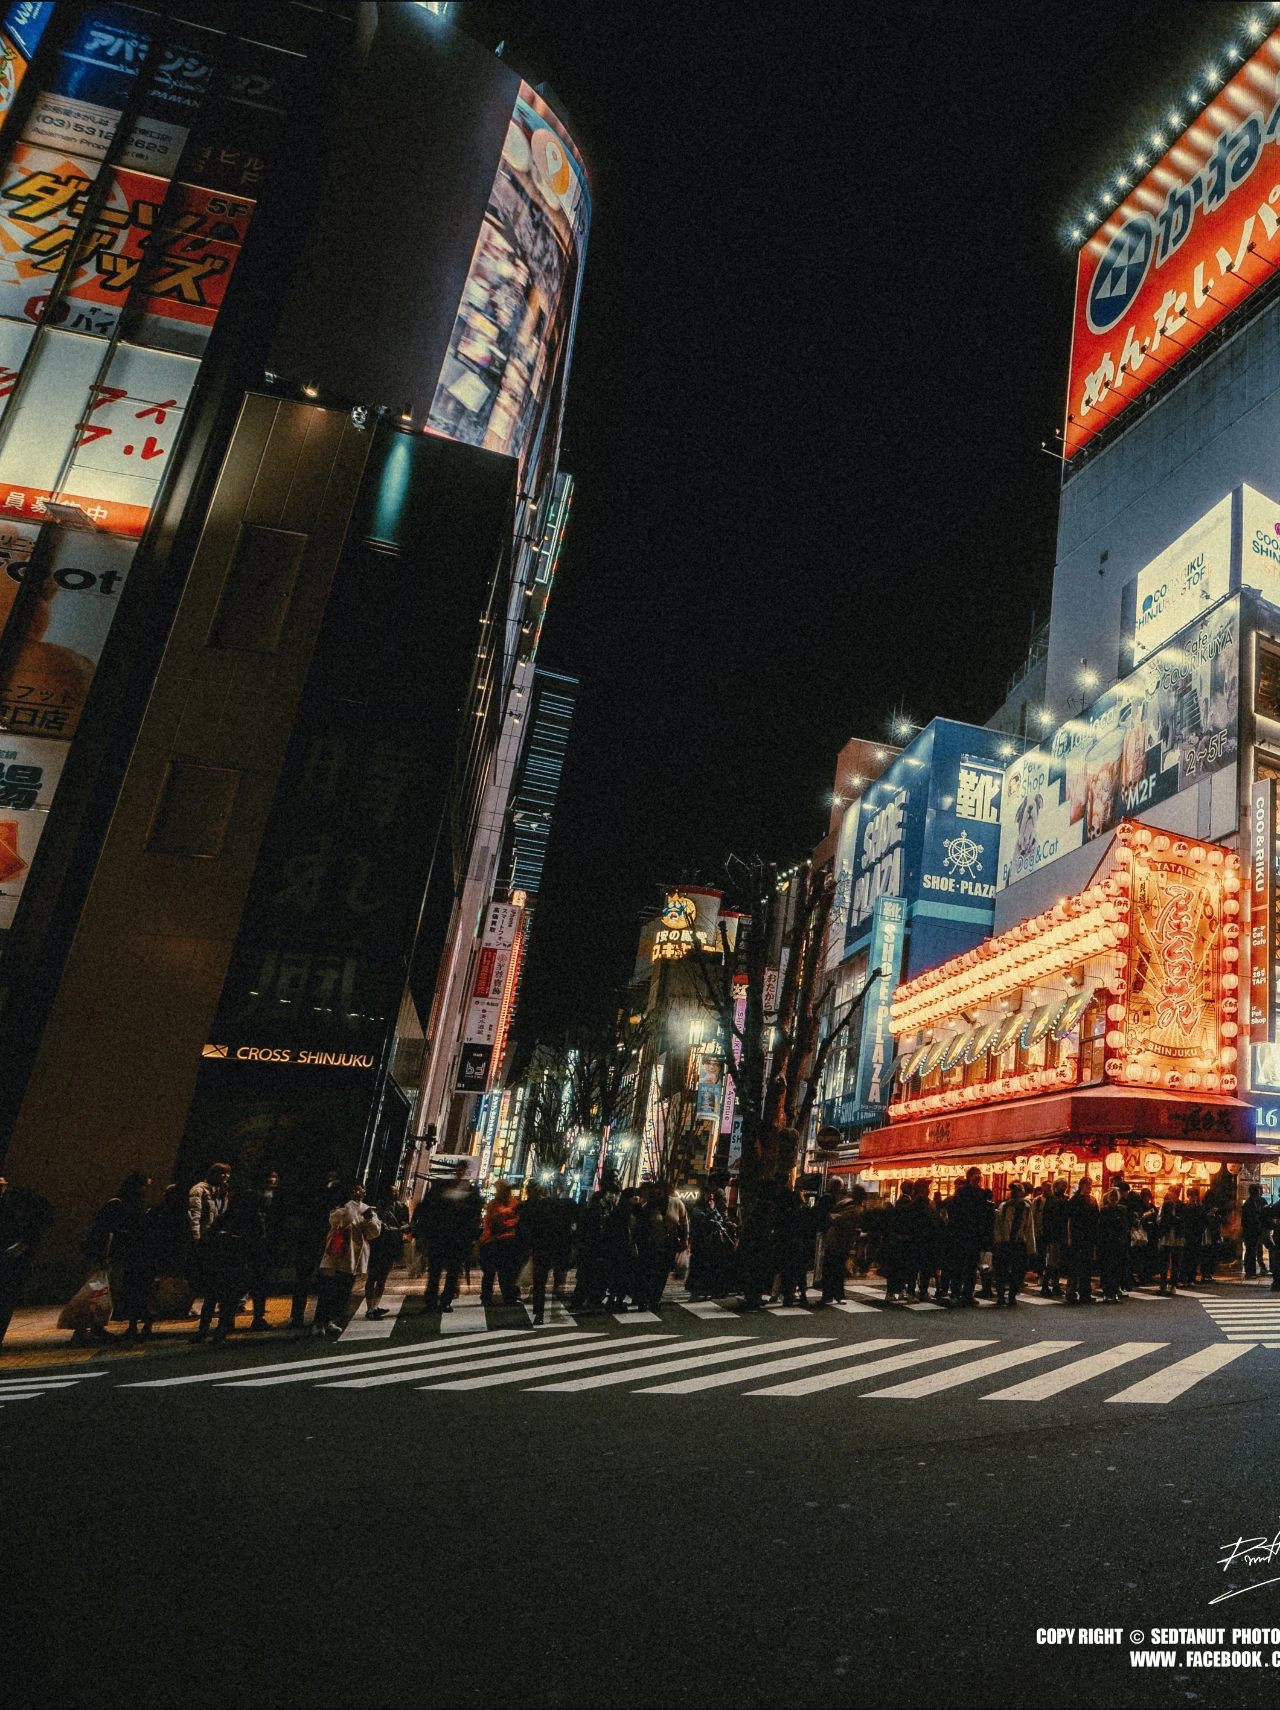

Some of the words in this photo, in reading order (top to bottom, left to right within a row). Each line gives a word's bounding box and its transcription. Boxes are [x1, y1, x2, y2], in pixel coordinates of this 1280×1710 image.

[207, 199, 250, 218] 5F
[957, 767, 1000, 823] 靴
[1021, 772, 1044, 799] Shop
[1127, 773, 1157, 811] M2F
[861, 790, 909, 869] SHOE
[1155, 862, 1202, 881] YATAIEN
[236, 1046, 291, 1063] CROSS
[298, 1050, 374, 1068] SHINJUKU
[1147, 1042, 1197, 1057] SHINJUKU
[1256, 1107, 1278, 1127] 16
